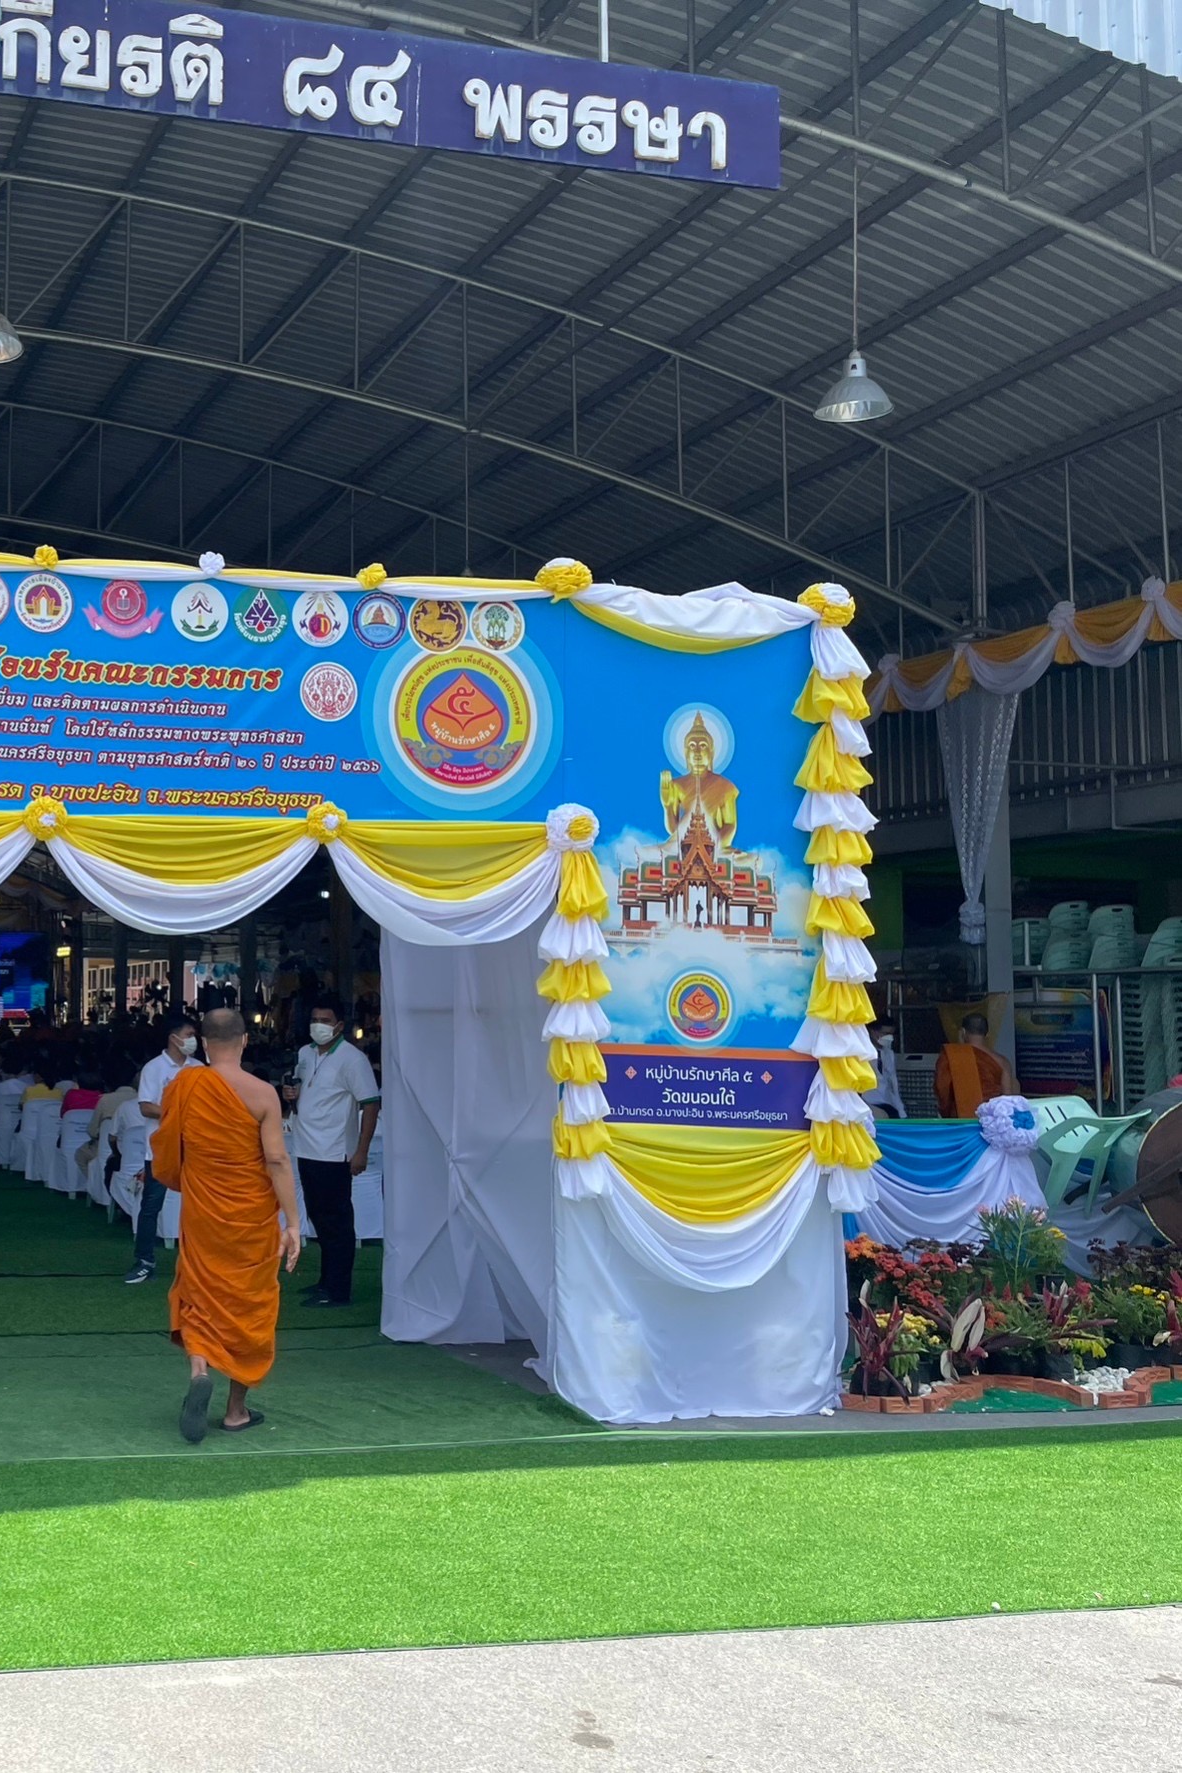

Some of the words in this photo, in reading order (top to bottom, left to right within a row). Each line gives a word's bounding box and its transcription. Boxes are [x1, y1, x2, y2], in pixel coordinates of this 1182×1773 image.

[282, 43, 413, 127] ๘๔
[462, 77, 730, 171] พรรษา
[32, 692, 227, 717] และติดตามผลการดำเนินงาน
[447, 686, 475, 715] ๕
[65, 719, 304, 747] โดยใช้หลักธรรมทางพระพุทธศาสนา
[98, 748, 230, 769] ตามยุทธศาสตร์ชาติ
[236, 758, 257, 770] ๒๐
[263, 754, 273, 770] ปี
[281, 755, 335, 772] ประจำปี
[341, 760, 382, 774] ๒๕๖๖
[30, 783, 139, 804] อ.บางปะอิน
[146, 788, 324, 814] จ.พระนครศรีอยุธยา
[645, 1065, 740, 1084] หมู่บ้านรักษาศีล
[743, 1070, 754, 1083] ๕
[661, 1087, 736, 1106] วัดขนอนใต้
[656, 1106, 705, 1119] อ.บางปะอิน
[706, 1109, 789, 1123] จ.พระนครศรีอยุธยา
